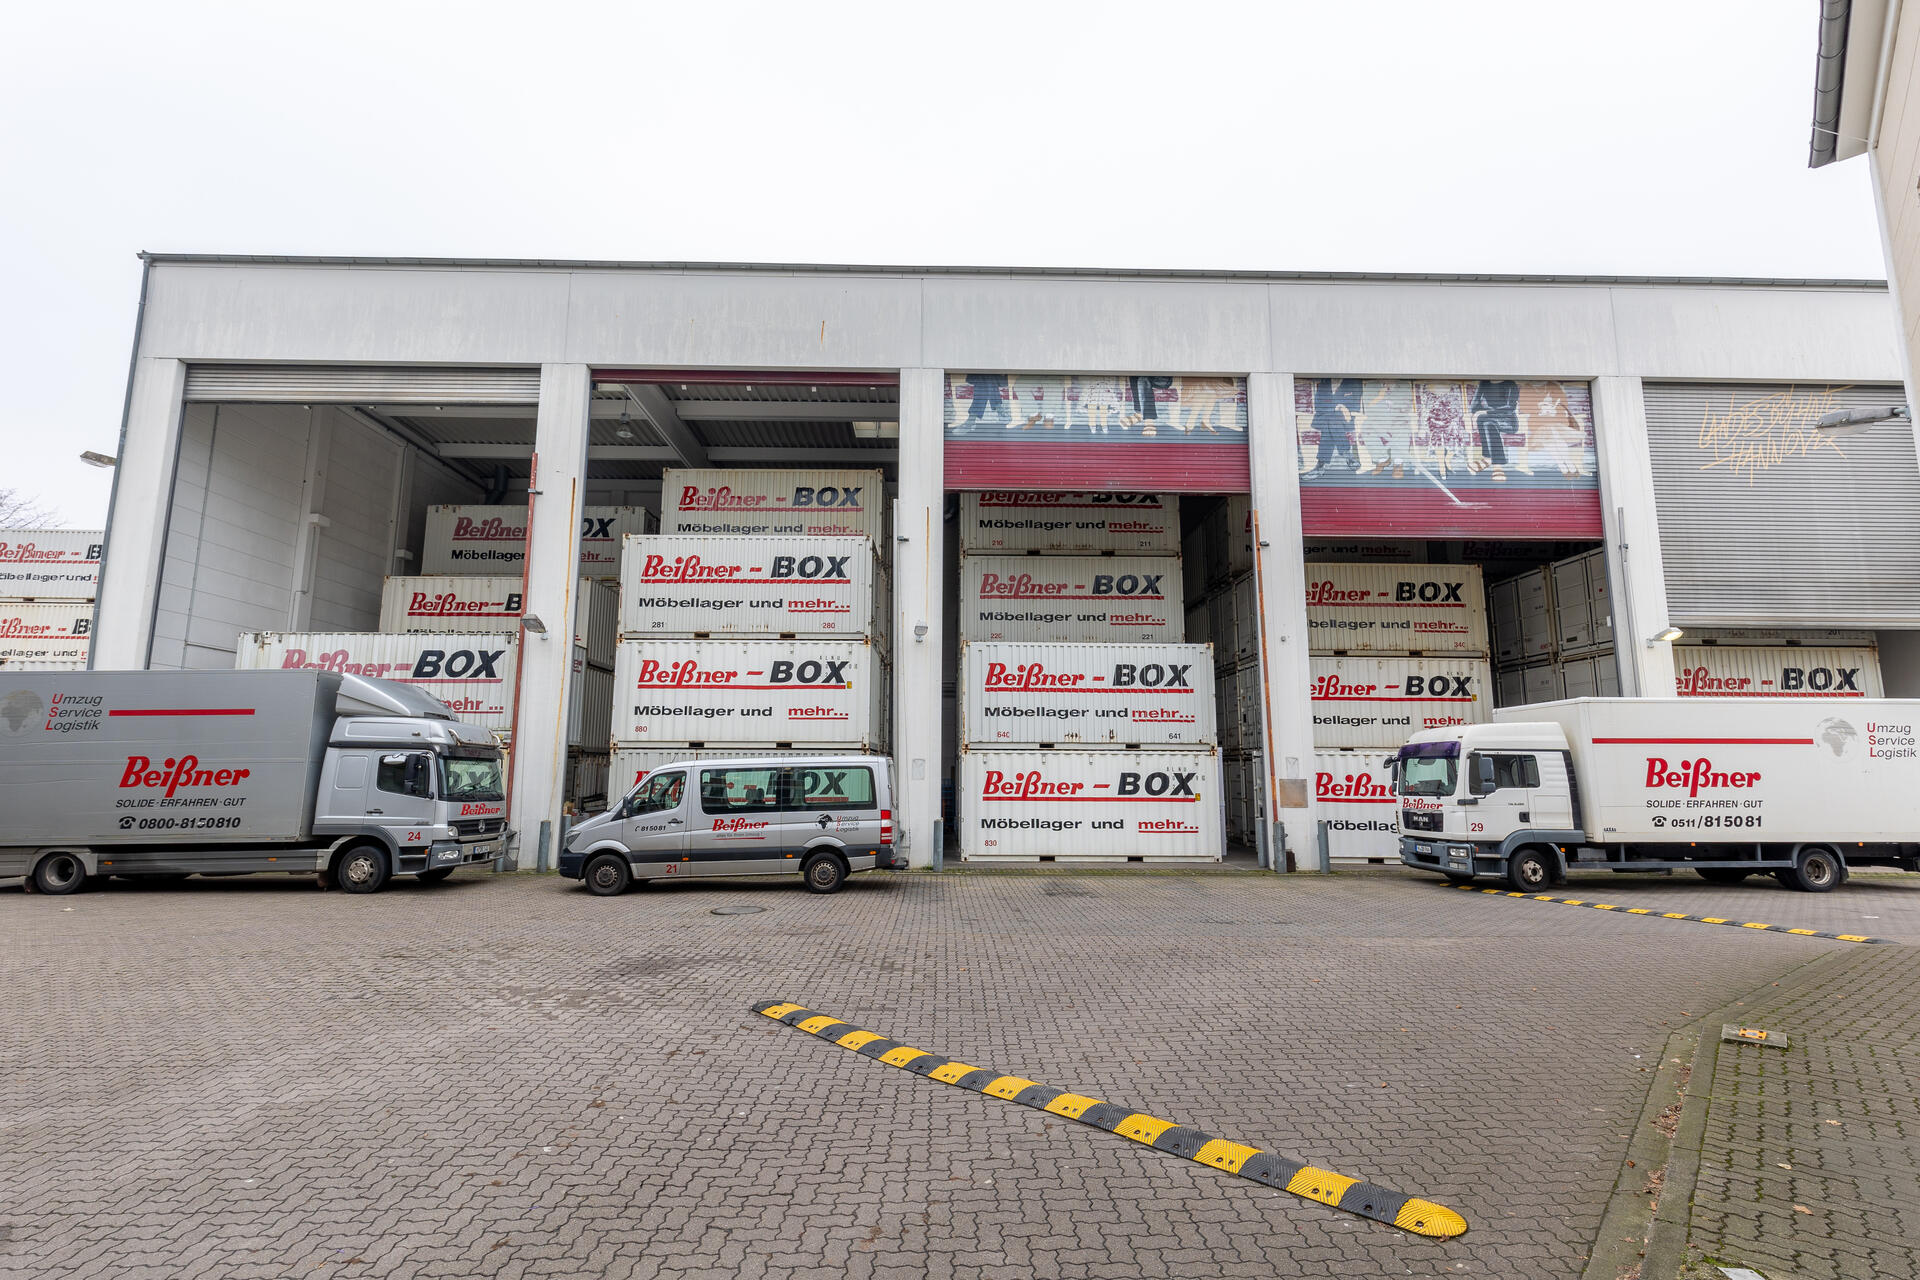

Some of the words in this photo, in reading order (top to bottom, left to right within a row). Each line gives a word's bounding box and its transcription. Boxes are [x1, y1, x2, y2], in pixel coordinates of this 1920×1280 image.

[679, 486, 767, 509] Beißner
[792, 487, 863, 507] BOX
[677, 523, 769, 535] Möbellager
[774, 524, 803, 533] und
[979, 519, 1072, 531] Möbellager
[1076, 520, 1105, 530] und
[1109, 521, 1164, 530] mehr...
[581, 551, 600, 562] ehr
[641, 555, 743, 582] Beißner
[770, 556, 851, 579] BOX
[0, 572, 65, 583] öbellager
[980, 574, 1067, 597] Beißner
[1092, 575, 1165, 595] BOX
[1305, 580, 1371, 603] eißner
[1396, 582, 1465, 602] BOX
[408, 592, 489, 614] Beißner
[639, 597, 743, 611] Möbellager
[749, 598, 783, 609] und
[788, 598, 850, 609] mehr...
[980, 612, 1072, 623] Möbellager
[1077, 612, 1107, 622] und
[1110, 613, 1166, 622] mehr...
[652, 621, 665, 629] 281
[1308, 619, 1376, 631] bellager
[1381, 620, 1410, 629] und
[1, 649, 49, 659] ellager
[53, 649, 78, 657] und
[412, 650, 506, 679] BOX
[638, 659, 738, 686] Beißner
[769, 660, 850, 684] BOX
[985, 662, 1085, 688] Beißner
[1112, 663, 1193, 687] BOX
[1310, 674, 1378, 699] eißner
[1405, 675, 1473, 697] BOX
[1675, 666, 1751, 694] eißner
[1780, 667, 1860, 691] BOX
[51, 693, 103, 707] Umzug
[48, 706, 103, 718] Service
[634, 706, 735, 719] Möbellager
[740, 706, 772, 717] und
[788, 706, 849, 717] mehr...
[984, 707, 1089, 720] Möbellager
[1095, 707, 1128, 717] und
[1132, 708, 1195, 719] mehr...
[44, 719, 101, 734] Logistik
[1313, 715, 1377, 726] bellager
[1382, 716, 1410, 726] und
[1866, 722, 1912, 736] Umzug
[1868, 735, 1915, 746] Service
[1870, 747, 1917, 761] Logistik
[118, 755, 250, 798] Beißner
[1645, 757, 1762, 798] Beißner
[982, 770, 1084, 797] Beißner
[1117, 772, 1196, 796] BOX
[116, 799, 156, 808] SOLIDE
[160, 797, 219, 808] ERFAHREN
[223, 797, 246, 807] GUT
[1402, 798, 1444, 810] Beißner
[1646, 799, 1681, 808] SOLIDE
[1686, 799, 1739, 808] ERFAHREN
[1743, 799, 1764, 808] GUT
[460, 802, 501, 817] Beißner
[712, 817, 769, 833] Beißner
[981, 819, 1083, 832] Möbellager
[1091, 819, 1125, 830] und
[1138, 819, 1200, 830] mehr...
[1318, 820, 1398, 834] öbellag
[1470, 823, 1484, 832] 29
[407, 831, 421, 842] 24
[984, 839, 998, 847] 830
[666, 864, 677, 874] 21
